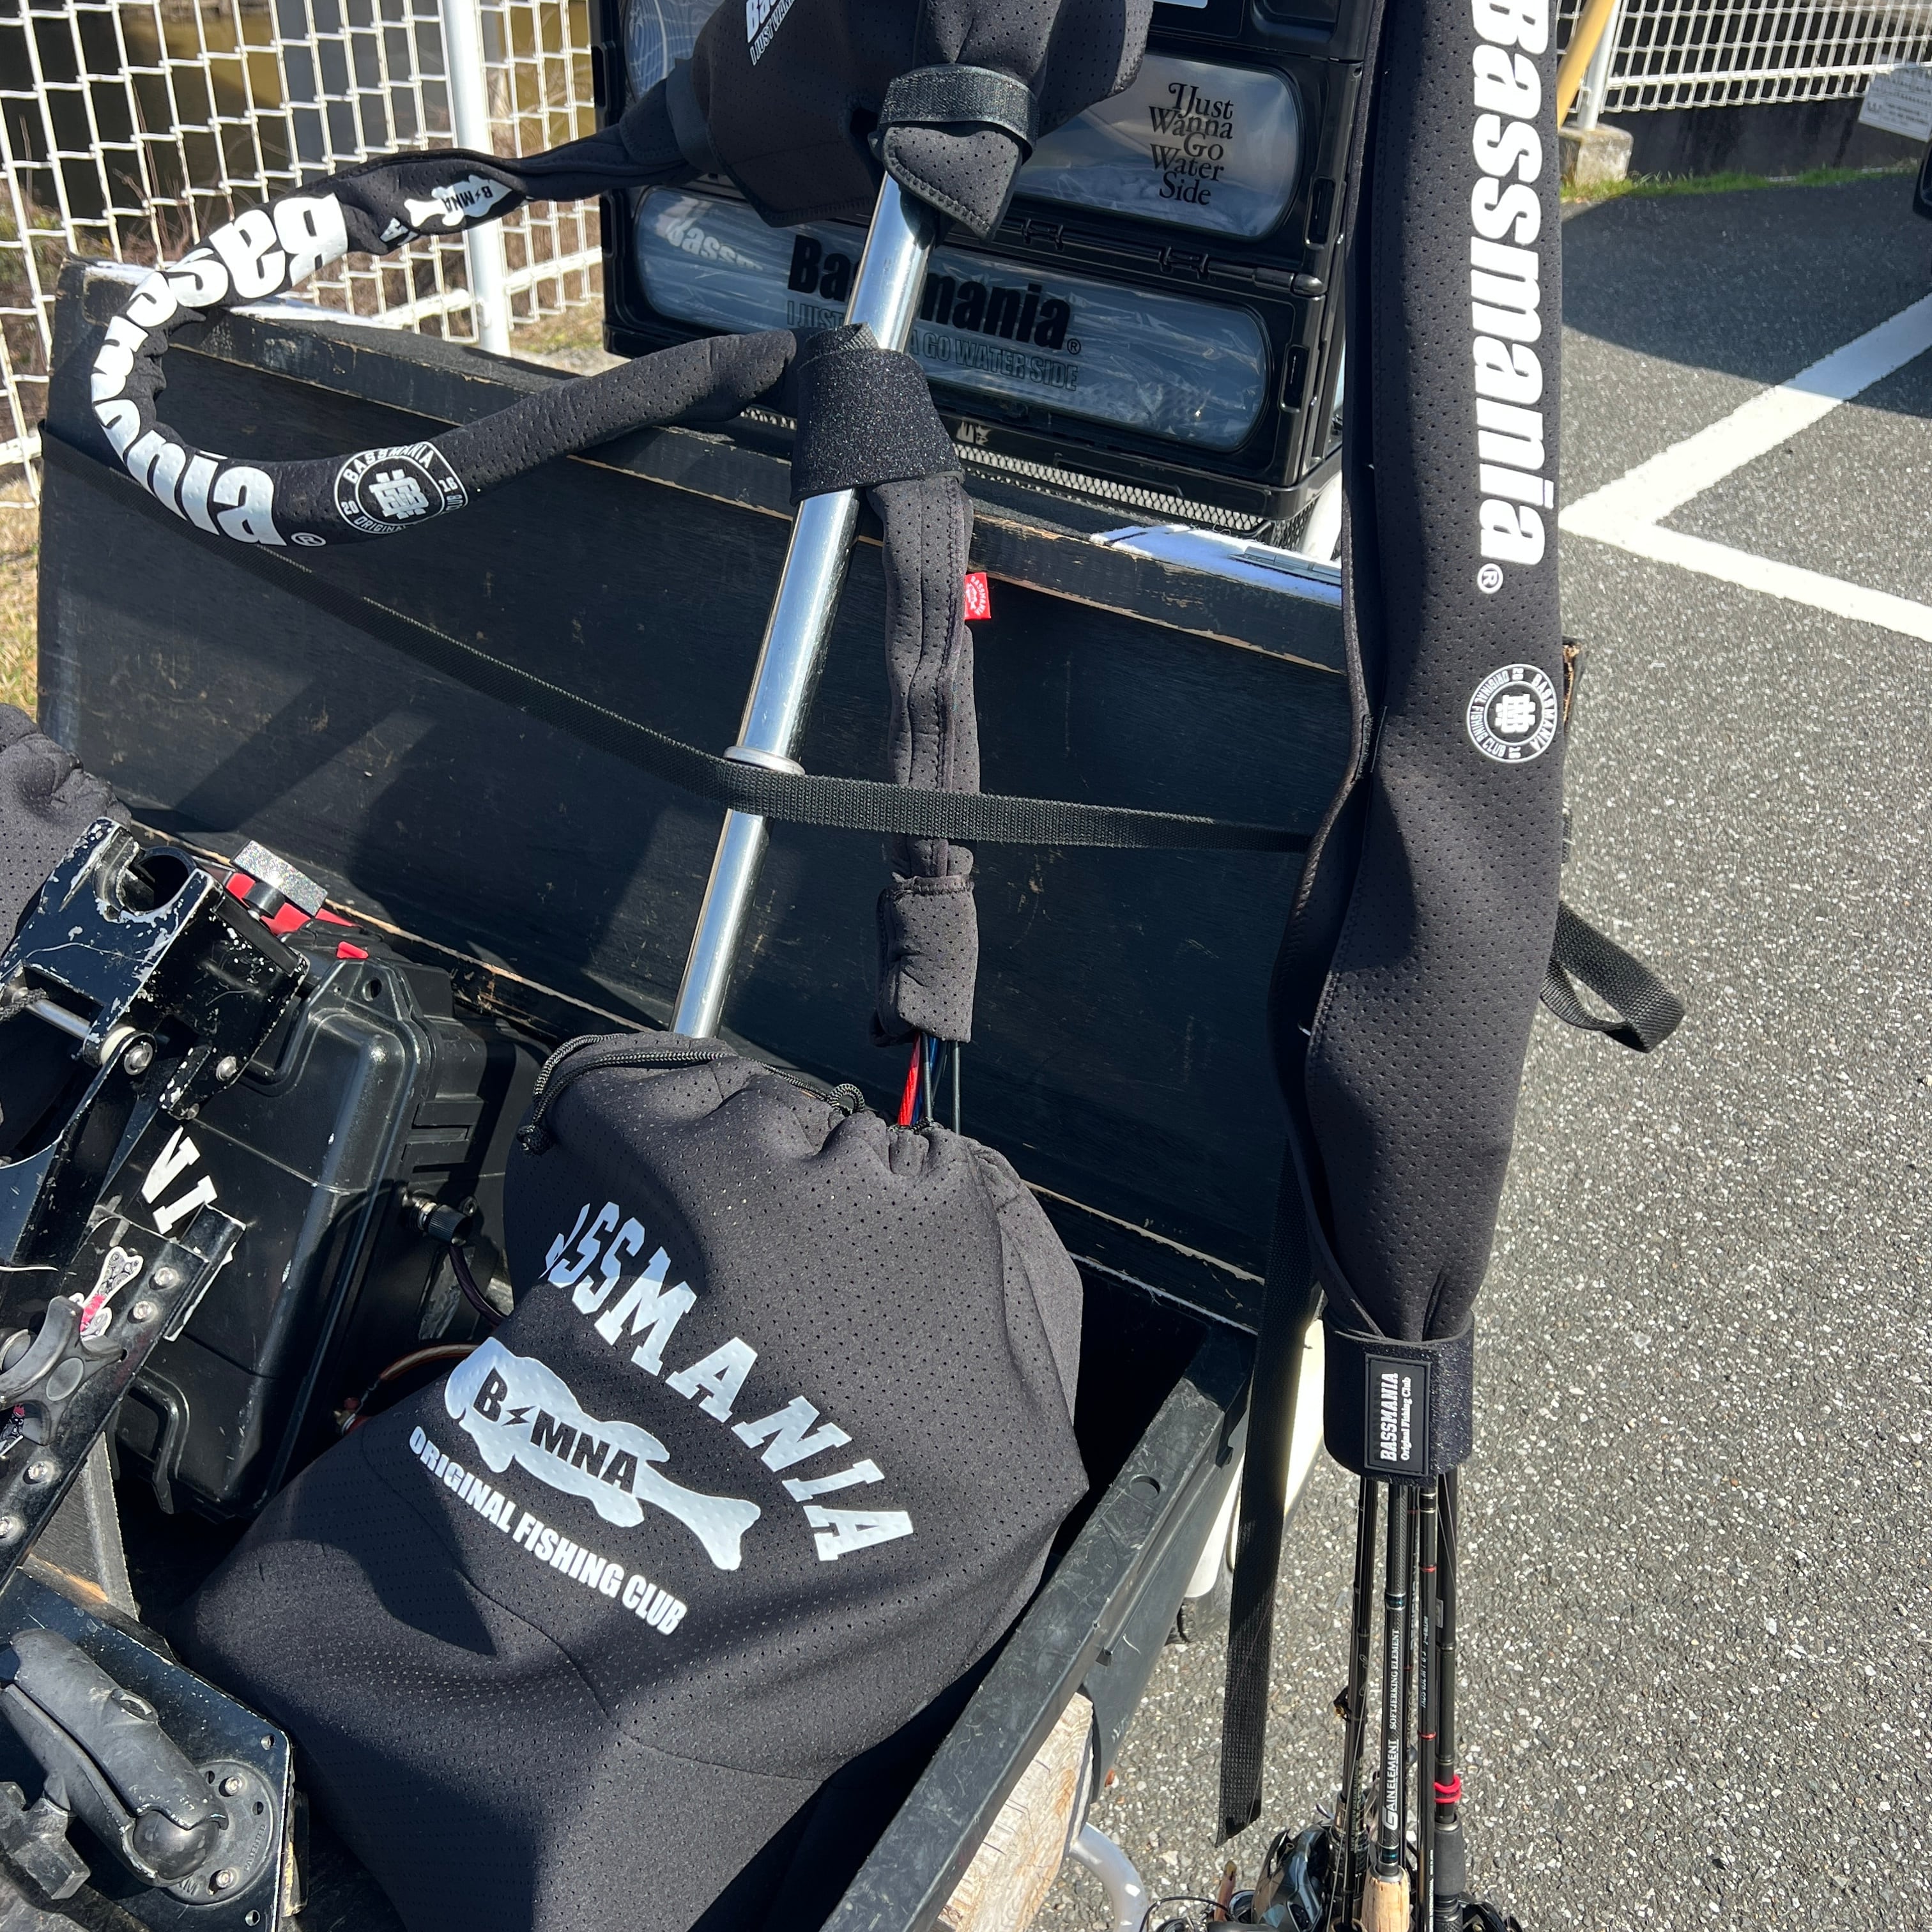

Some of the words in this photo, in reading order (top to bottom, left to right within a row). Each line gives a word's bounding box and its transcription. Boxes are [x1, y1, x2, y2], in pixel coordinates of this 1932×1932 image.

[754, 19, 774, 60] JUST
[1177, 85, 1234, 120] Just
[1148, 105, 1233, 139] Wanna
[1150, 143, 1224, 181] Water
[1183, 132, 1224, 160] Go
[1159, 171, 1211, 205] Side
[923, 332, 951, 362] GO
[955, 337, 1026, 380] WATER
[1030, 356, 1078, 392] SIDE
[343, 445, 434, 484] BASSMANIA
[341, 500, 359, 515] 20
[1475, 670, 1510, 703] ORIGINAL
[1471, 705, 1489, 742] FISHING
[1531, 673, 1555, 751] BASSMANIA
[1482, 737, 1506, 758] CLUB
[1401, 1377, 1412, 1397] Club
[1380, 1373, 1399, 1462] BASSMANIA
[1401, 1398, 1413, 1429] Fishing
[1400, 1428, 1412, 1461] Original
[409, 1425, 516, 1533] ORIGINAL
[512, 1512, 625, 1598] FISHING
[622, 1574, 688, 1636] CLUB
[1391, 1629, 1400, 1670] ELEMENT
[1390, 1671, 1399, 1730] SOFTJERKING
